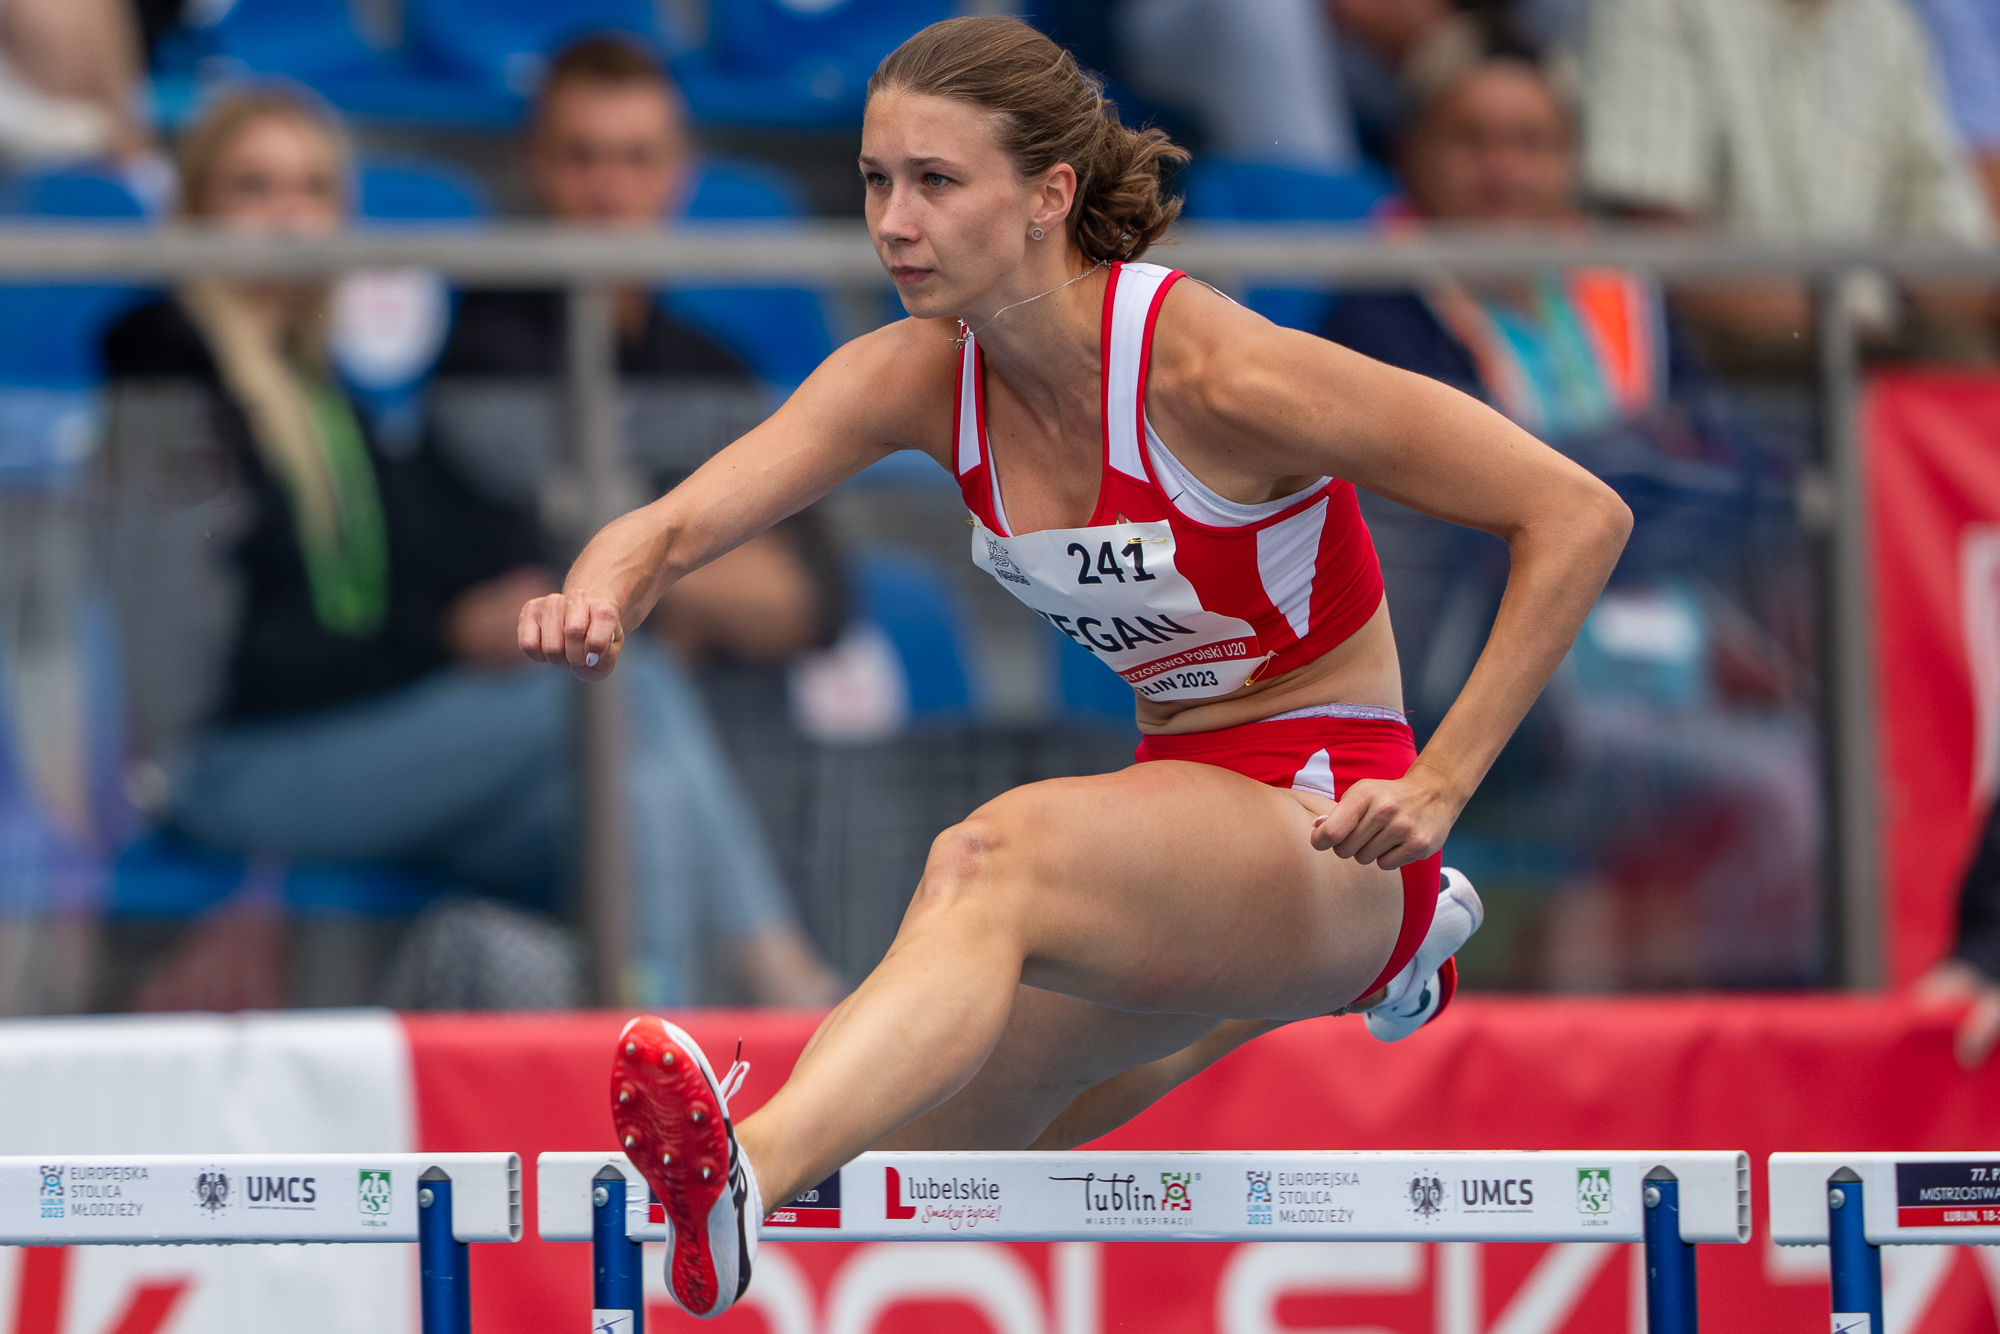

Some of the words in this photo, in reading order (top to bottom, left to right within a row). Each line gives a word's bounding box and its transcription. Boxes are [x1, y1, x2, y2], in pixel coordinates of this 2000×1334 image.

[1067, 537, 1156, 585] 241
[1032, 607, 1198, 653] EGAN
[1124, 656, 1186, 682] trzostwa
[1184, 645, 1223, 662] Polski
[1223, 641, 1247, 657] U20
[1176, 670, 1219, 689] 2023
[71, 1166, 149, 1182] EUROPEJSKA
[1278, 1172, 1361, 1188] EUROPEJSKA
[1970, 1168, 1990, 1181] 77.
[71, 1185, 123, 1198] STOLICA
[246, 1176, 316, 1203] UMCS
[908, 1177, 1000, 1200] lubelskie
[1461, 1179, 1534, 1206] UMCS
[1278, 1191, 1333, 1204] STOLICA
[40, 1207, 65, 1218] 2023
[1247, 1213, 1273, 1225] 2023
[1278, 1206, 1355, 1222] MŁODZIEŻY
[1085, 1217, 1127, 1225] MIASTO
[1131, 1217, 1194, 1226] INSPIRACJI
